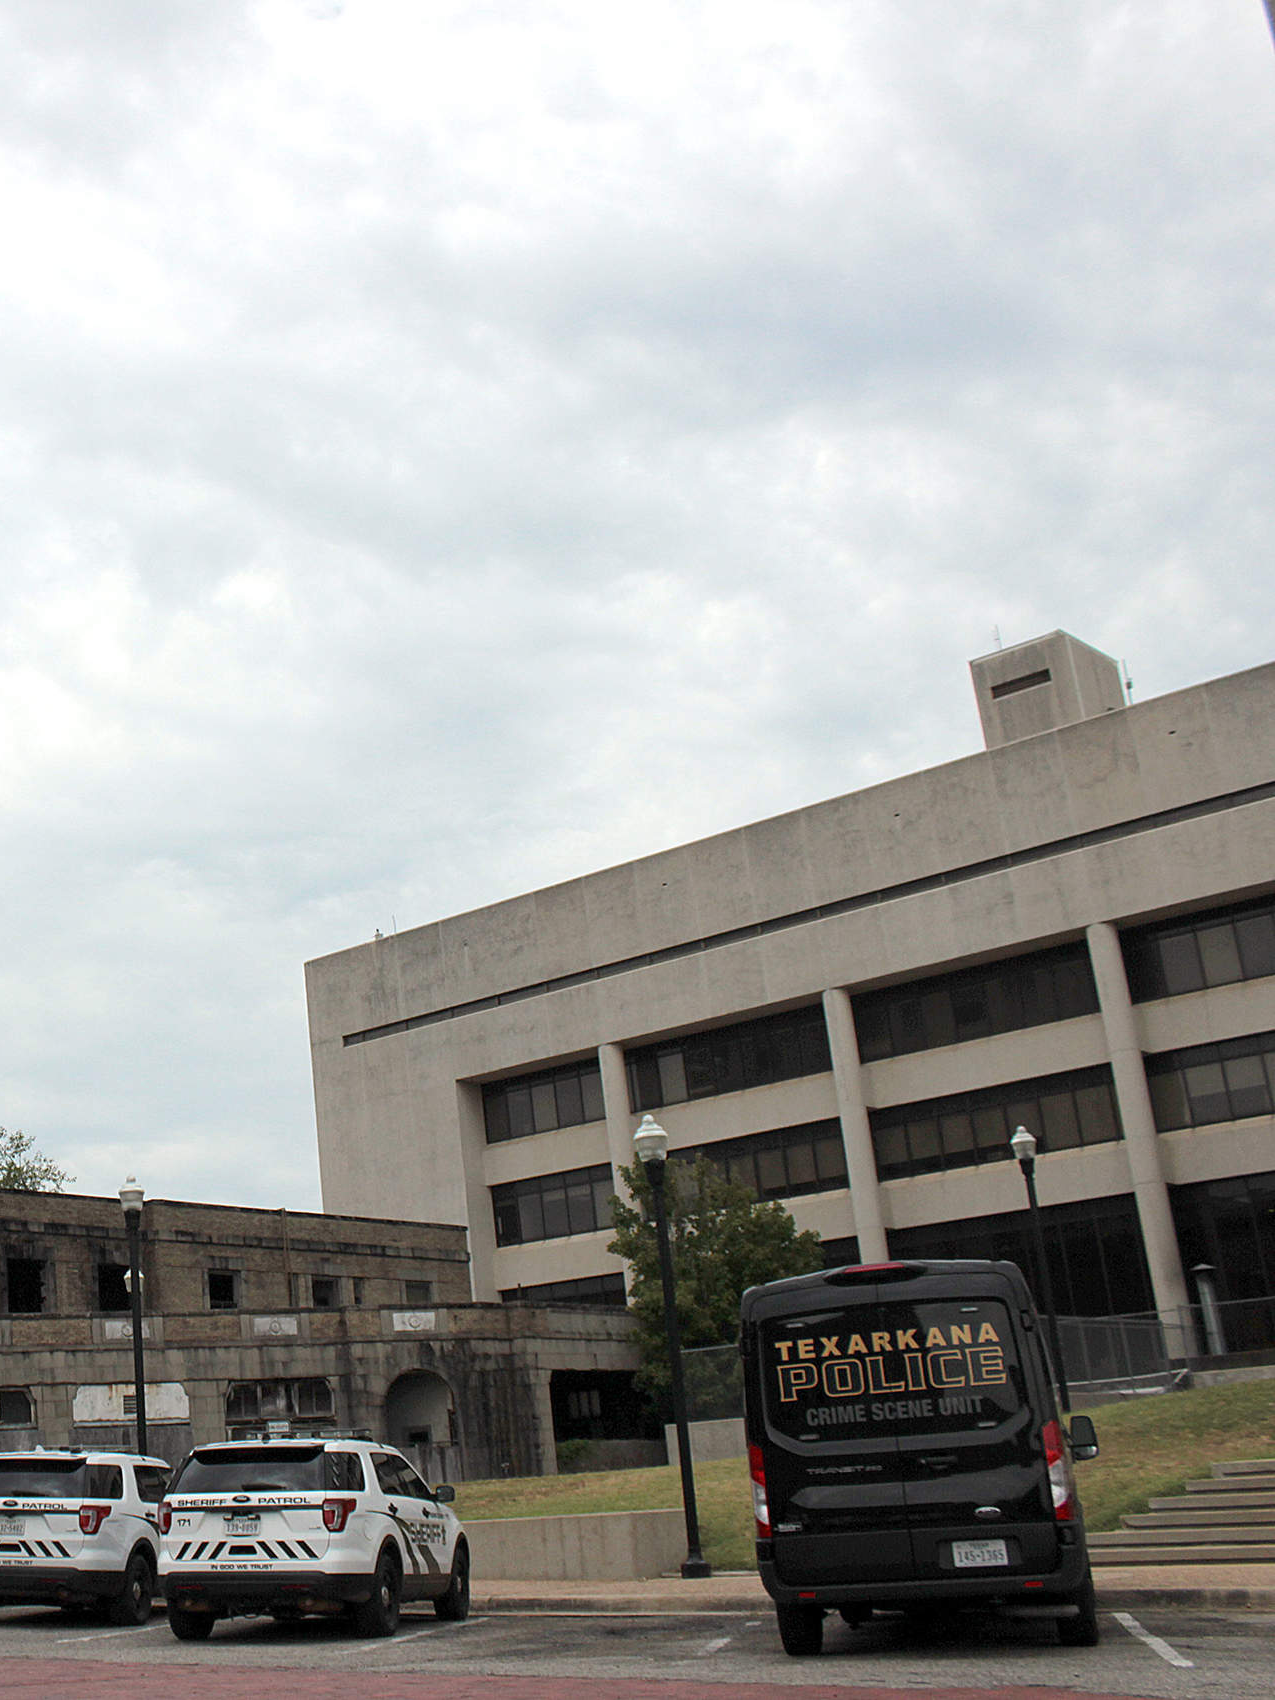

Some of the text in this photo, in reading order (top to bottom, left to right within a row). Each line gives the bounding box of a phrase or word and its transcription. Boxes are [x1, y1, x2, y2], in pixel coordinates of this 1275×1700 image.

[775, 1322, 1000, 1361] TEXARKANA
[777, 1346, 1007, 1402] POLICE
[806, 1395, 983, 1427] CRIME SCENE UNIT
[22, 1502, 67, 1510] PATROL
[177, 1497, 311, 1507] SHERIFF PATROL
[177, 1518, 191, 1527] 171
[410, 1522, 441, 1544] SHERIFF
